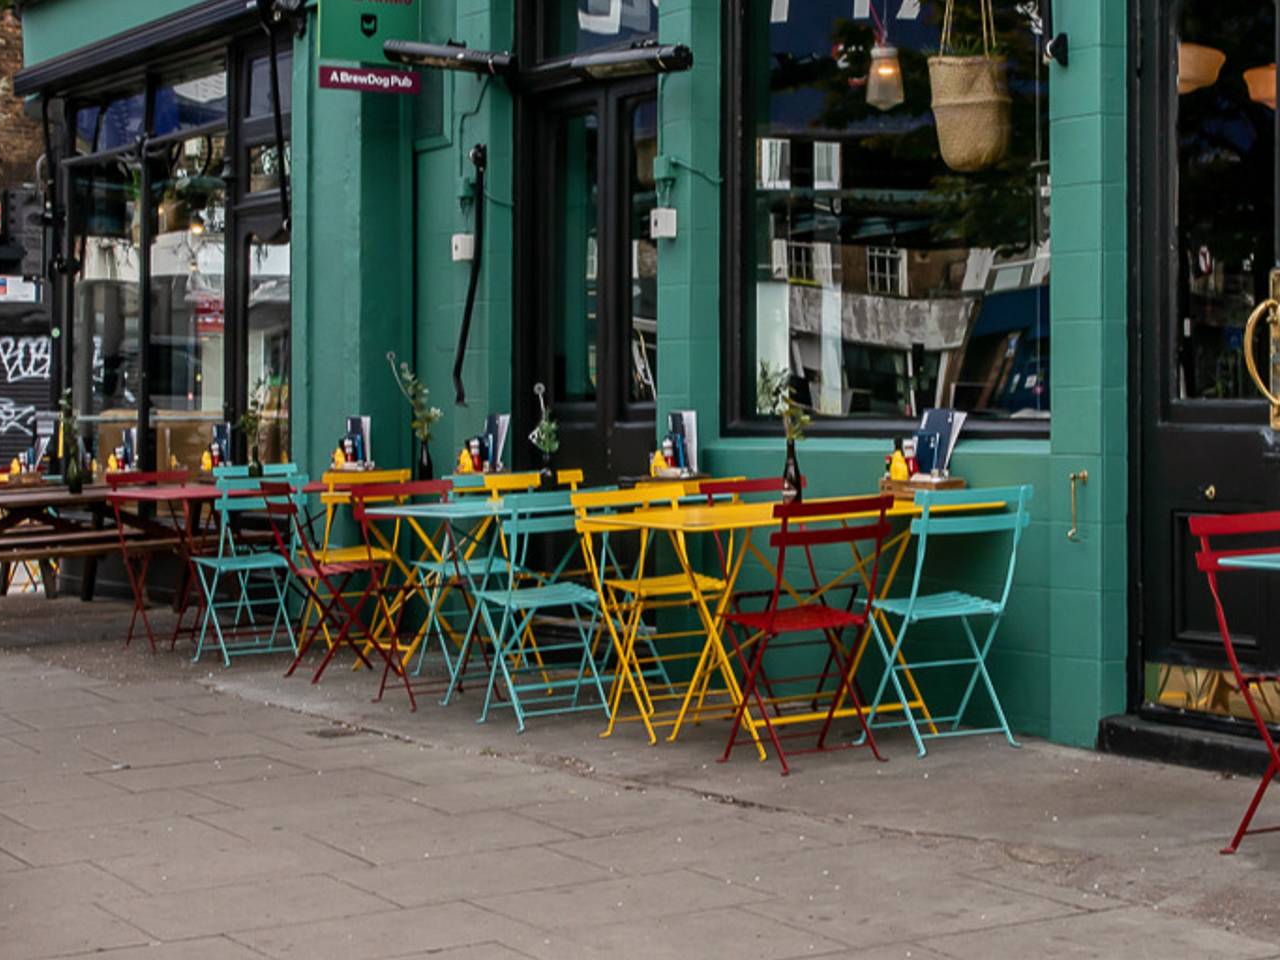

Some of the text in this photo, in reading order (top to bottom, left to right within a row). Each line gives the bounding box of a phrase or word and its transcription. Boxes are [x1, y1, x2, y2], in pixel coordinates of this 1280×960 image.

[330, 70, 413, 88] A BrewDog Pub
